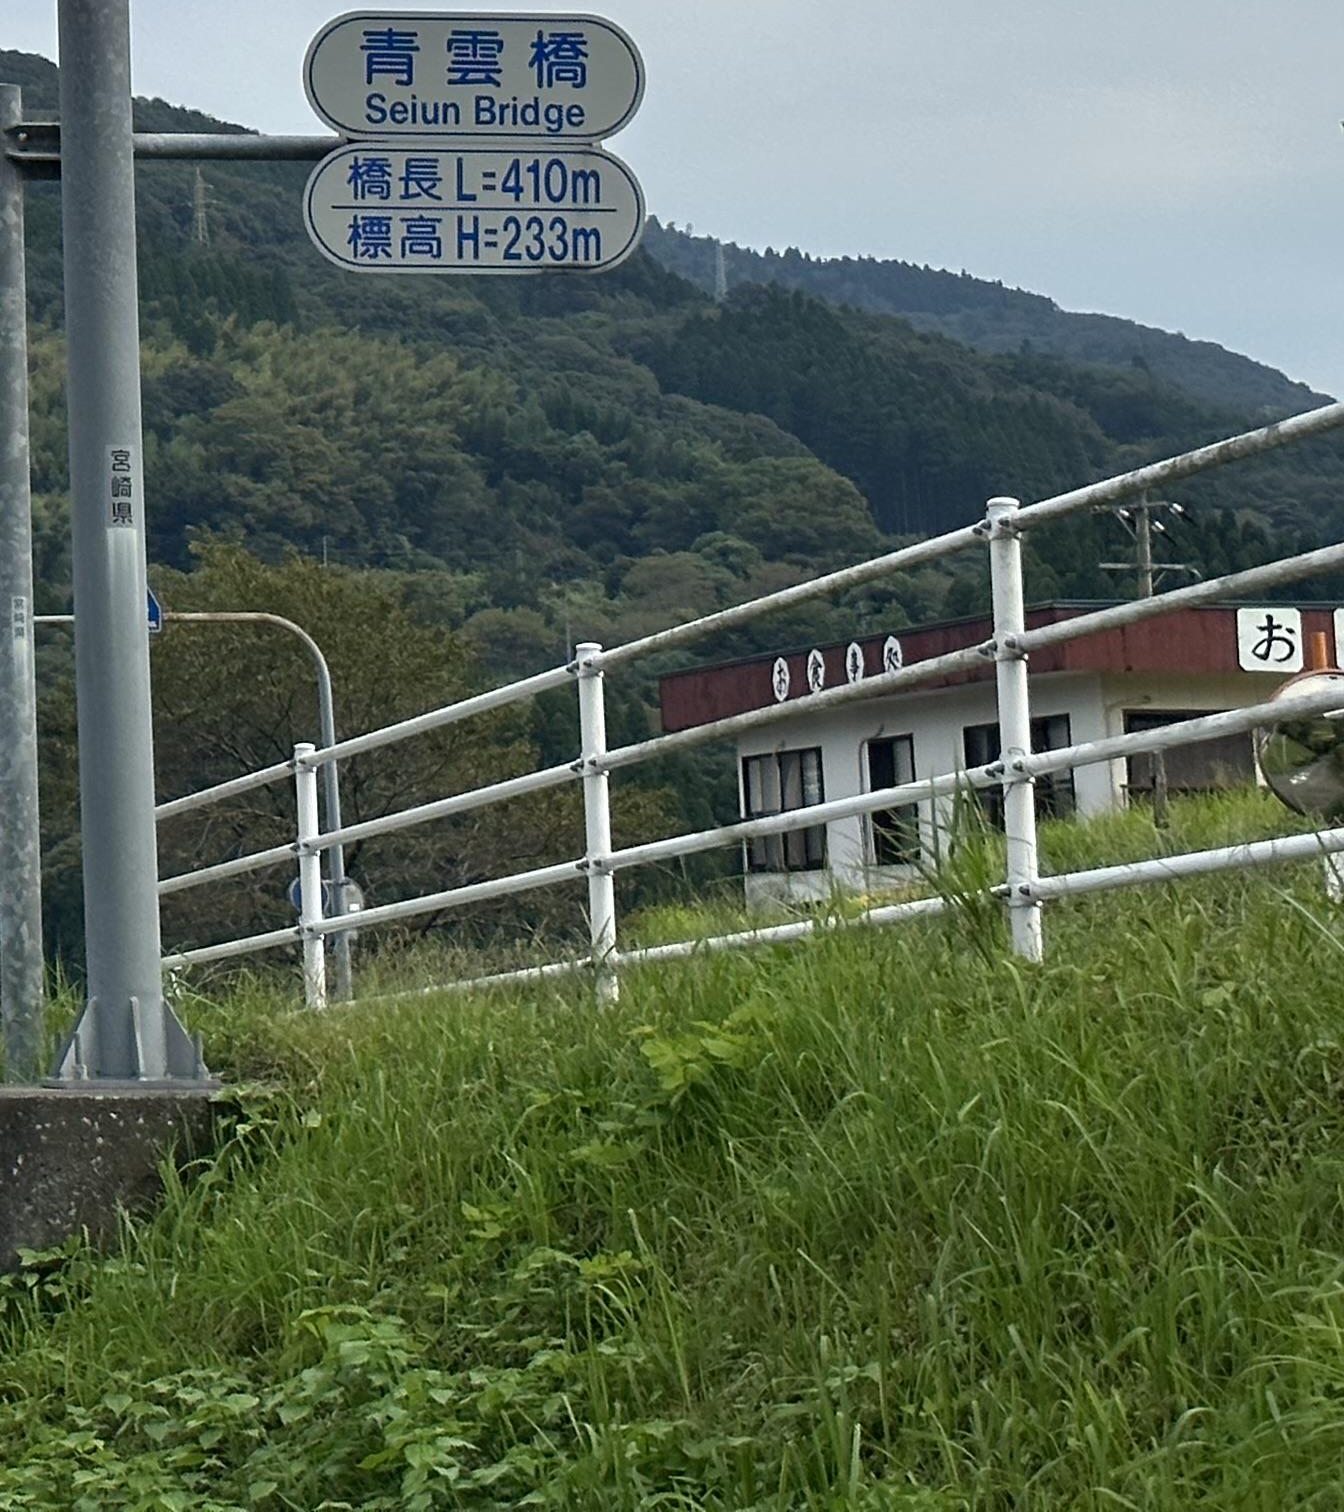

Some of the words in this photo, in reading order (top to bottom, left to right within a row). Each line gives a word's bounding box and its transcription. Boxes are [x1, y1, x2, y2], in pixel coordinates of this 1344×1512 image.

[360, 28, 589, 89] 青雲橋
[365, 93, 461, 125] Seiun
[474, 96, 586, 132] Bridge
[347, 157, 443, 202] 橋長
[457, 158, 600, 204] L=410m
[347, 214, 443, 260] 標高
[457, 216, 601, 262] H=233m
[1252, 614, 1296, 663] お
